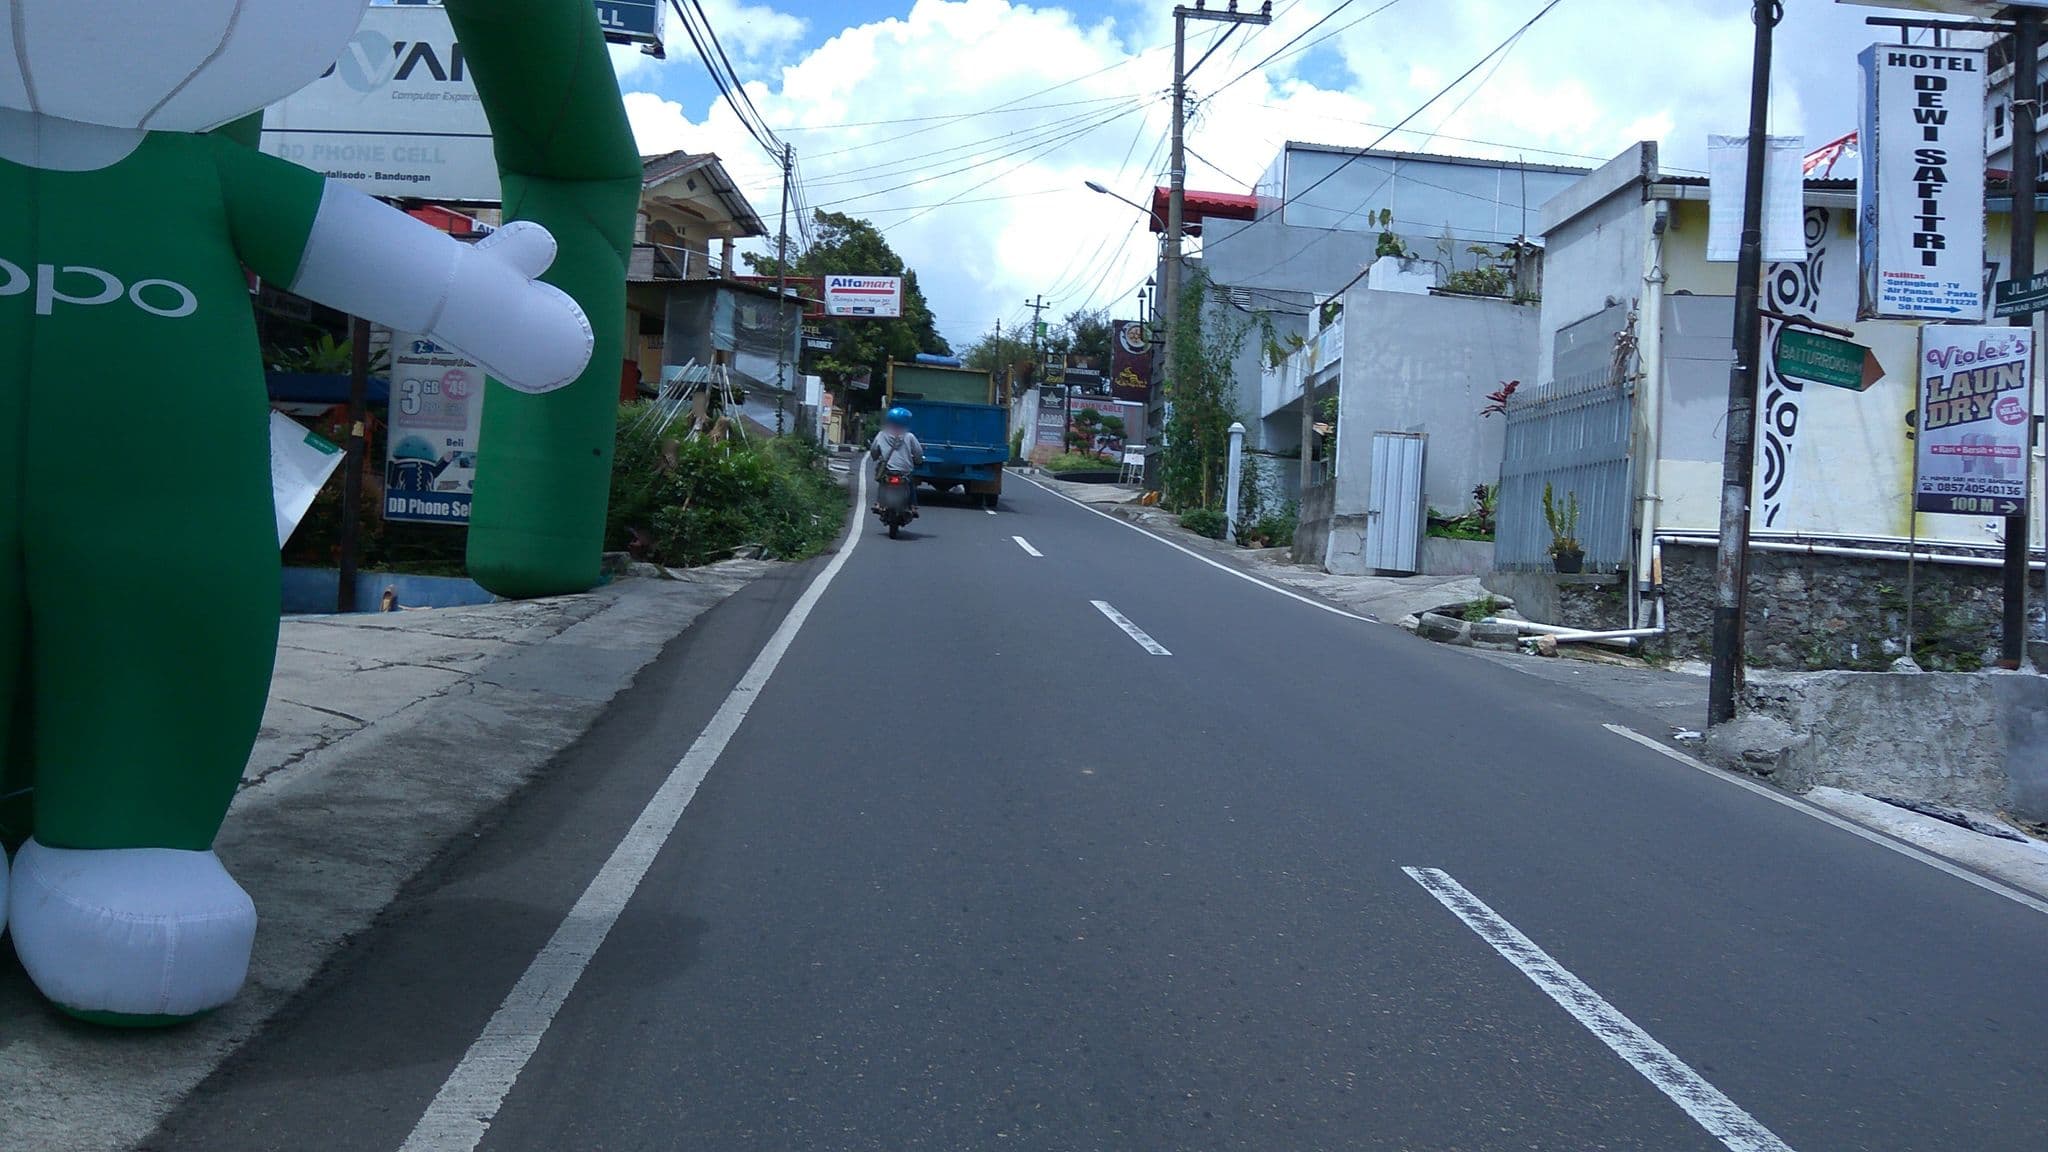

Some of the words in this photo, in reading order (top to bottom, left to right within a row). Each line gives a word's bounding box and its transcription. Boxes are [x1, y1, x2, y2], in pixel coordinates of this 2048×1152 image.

[1888, 53, 1977, 72] HOTEL
[1912, 75, 1948, 141] DEWI
[375, 171, 431, 183] Bandungan
[1912, 149, 1948, 267] SAFITRI
[831, 278, 894, 288] Alfamart
[1883, 271, 1926, 279] Fasilitas
[1926, 360, 2025, 404] LAUN
[400, 379, 421, 415] 3
[423, 381, 439, 394] GB
[1925, 392, 1998, 430] DRY
[446, 438, 464, 447] Beli
[1937, 483, 2021, 495] 085740540136
[388, 497, 406, 512] DD
[408, 498, 449, 516] Phone
[1950, 497, 1977, 512] 100
[1980, 499, 1994, 512] M
